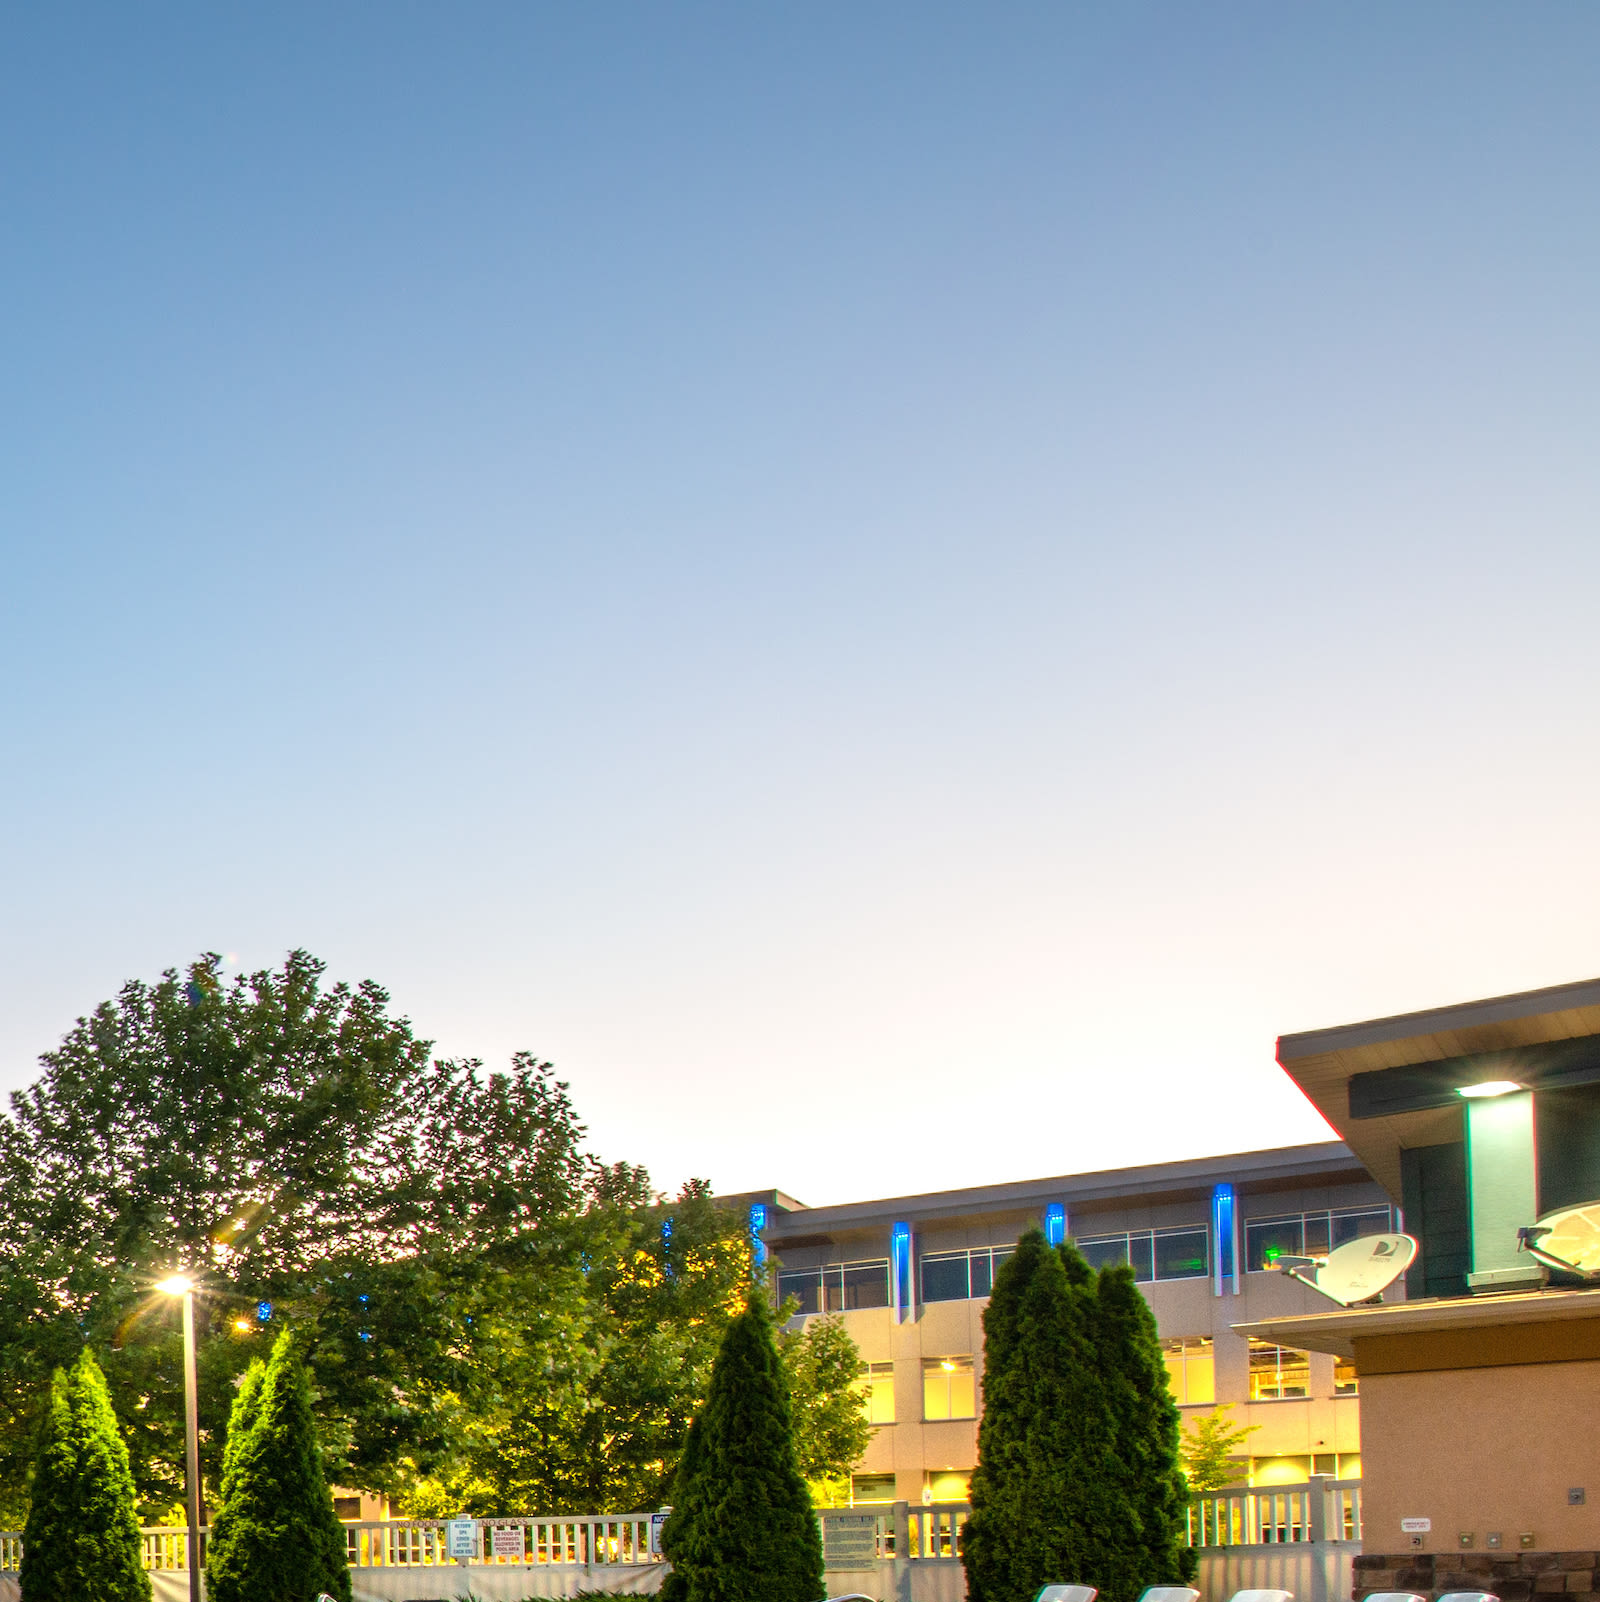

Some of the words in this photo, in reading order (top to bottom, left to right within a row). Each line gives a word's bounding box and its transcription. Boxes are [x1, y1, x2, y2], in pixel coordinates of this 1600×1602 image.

[396, 1520, 410, 1528] NO
[412, 1520, 439, 1528] FOOD
[482, 1519, 495, 1527] NO
[497, 1518, 528, 1527] GLASS
